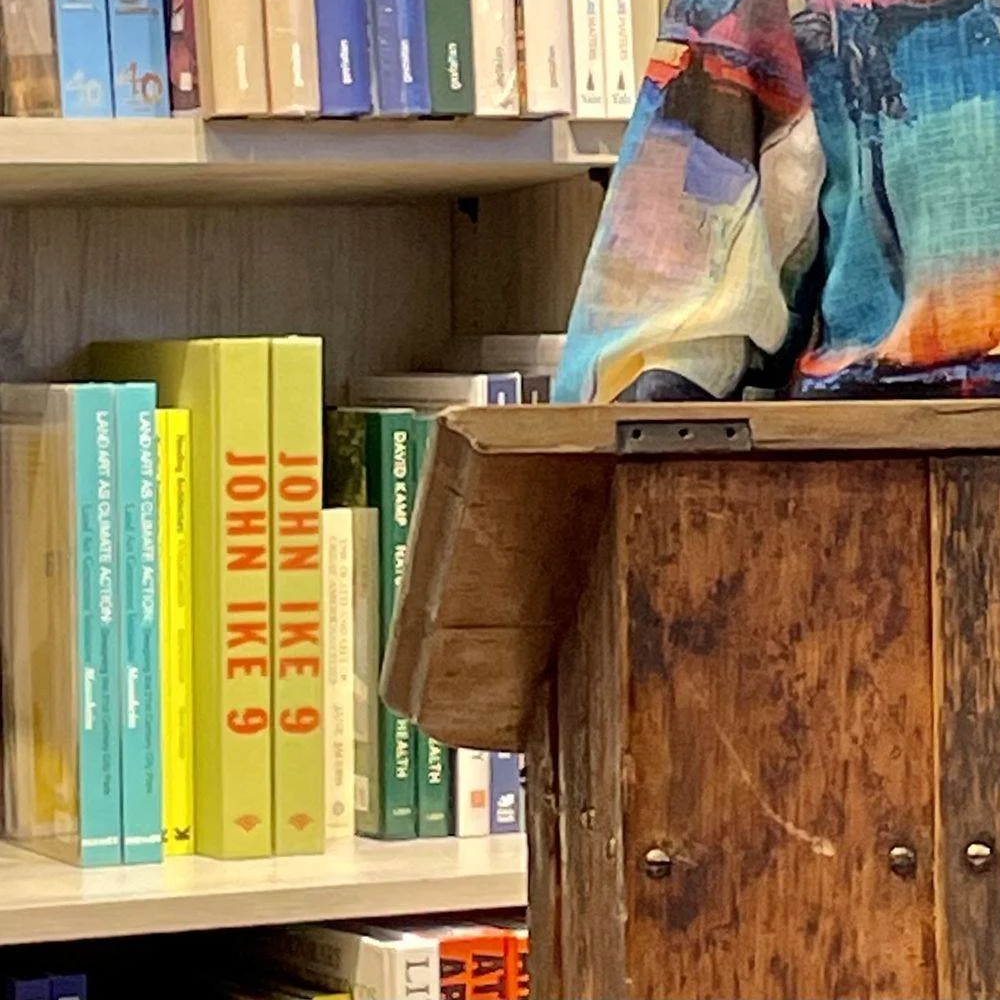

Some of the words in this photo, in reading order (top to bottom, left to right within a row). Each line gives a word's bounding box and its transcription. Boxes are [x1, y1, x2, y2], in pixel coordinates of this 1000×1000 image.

[95, 411, 109, 448] LAND
[138, 411, 152, 448] LAND
[97, 450, 110, 477] ART
[140, 450, 153, 477] ART
[393, 431, 407, 478] DAVID
[97, 480, 110, 499] AS
[140, 480, 153, 499] AS
[226, 451, 267, 572] JOHN
[278, 451, 320, 572] JOHN
[394, 482, 408, 526] KAMP
[98, 502, 111, 562] CLIMATE
[140, 502, 154, 562] CLIMATE
[226, 602, 267, 680] IKE
[279, 602, 320, 680] IKE
[227, 707, 268, 734] 9
[279, 707, 321, 734] 9
[395, 718, 411, 778] HEALTH
[427, 737, 442, 784] EALTH
